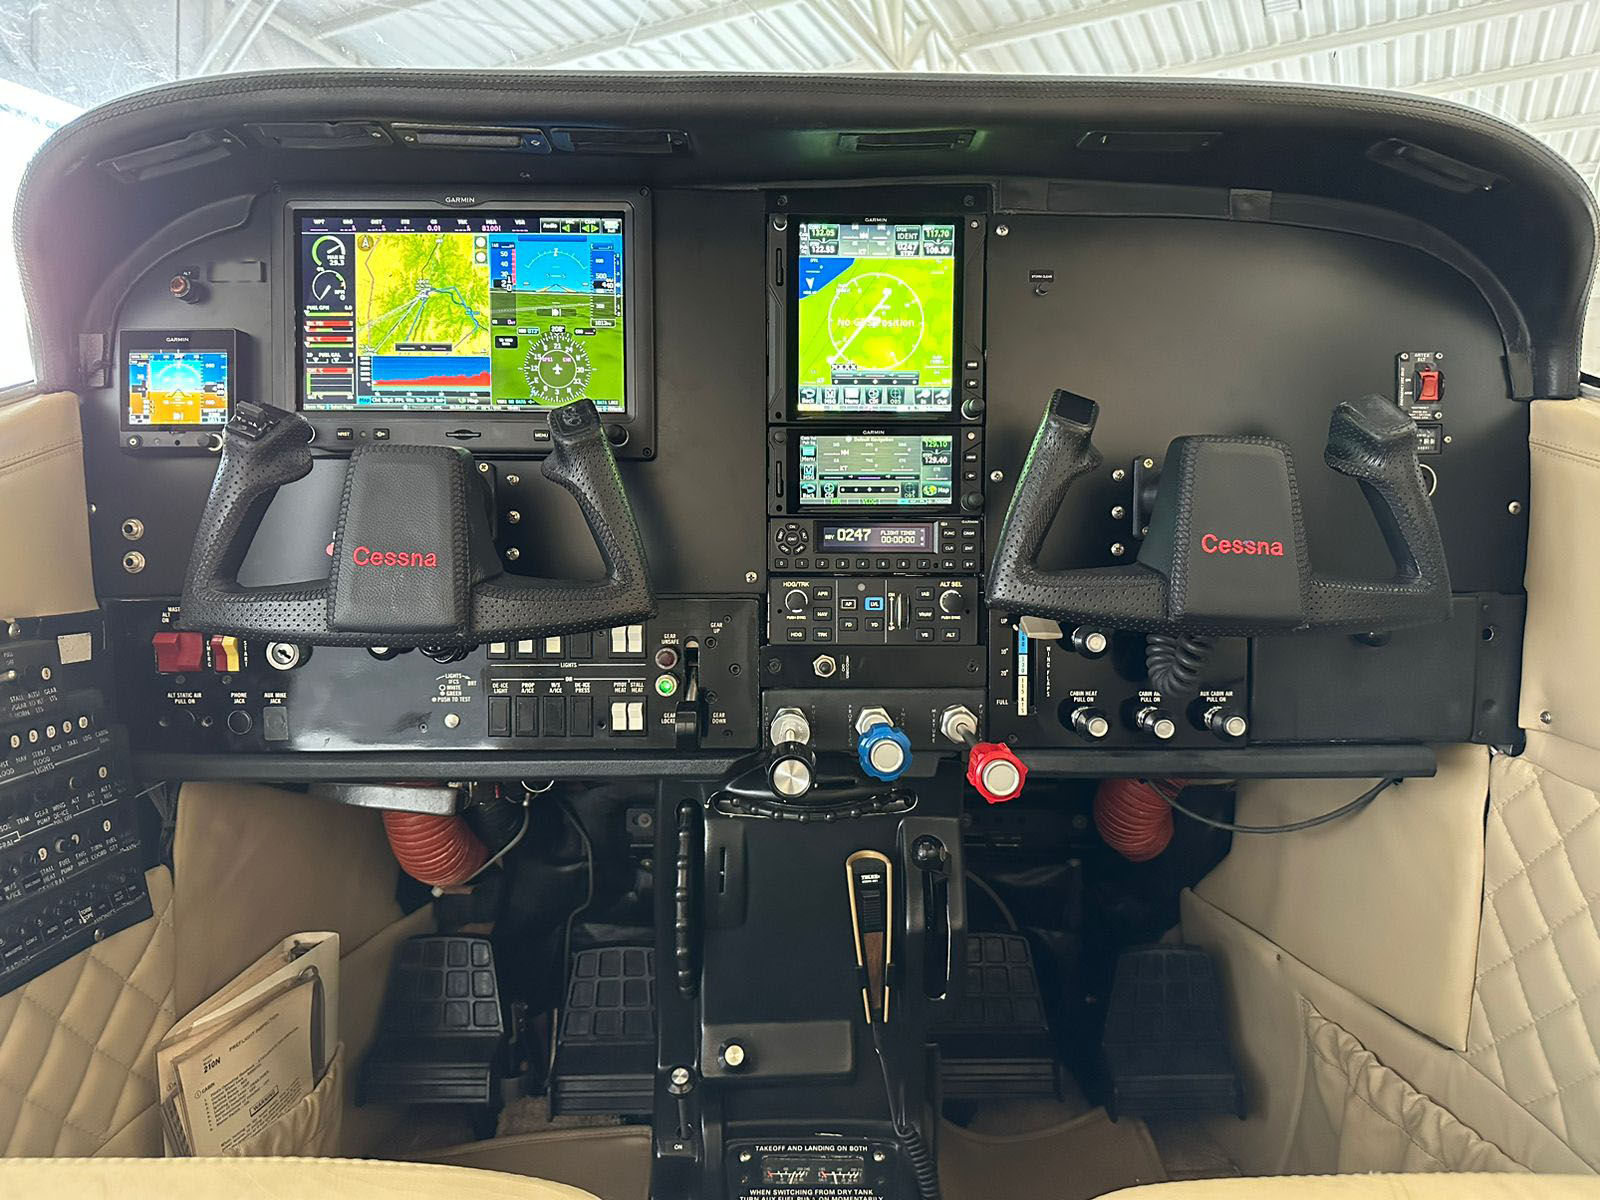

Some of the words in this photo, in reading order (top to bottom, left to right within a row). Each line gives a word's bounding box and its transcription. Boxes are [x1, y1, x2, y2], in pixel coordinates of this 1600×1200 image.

[896, 242, 918, 251] 0247
[836, 528, 872, 542] 0247
[880, 536, 916, 544] 00:00:00
[1201, 533, 1284, 556] Cessna
[353, 546, 437, 568] Cessna
[34, 764, 55, 776] LIGHTS
[34, 809, 49, 819] GEAR
[203, 1056, 221, 1074] 210N
